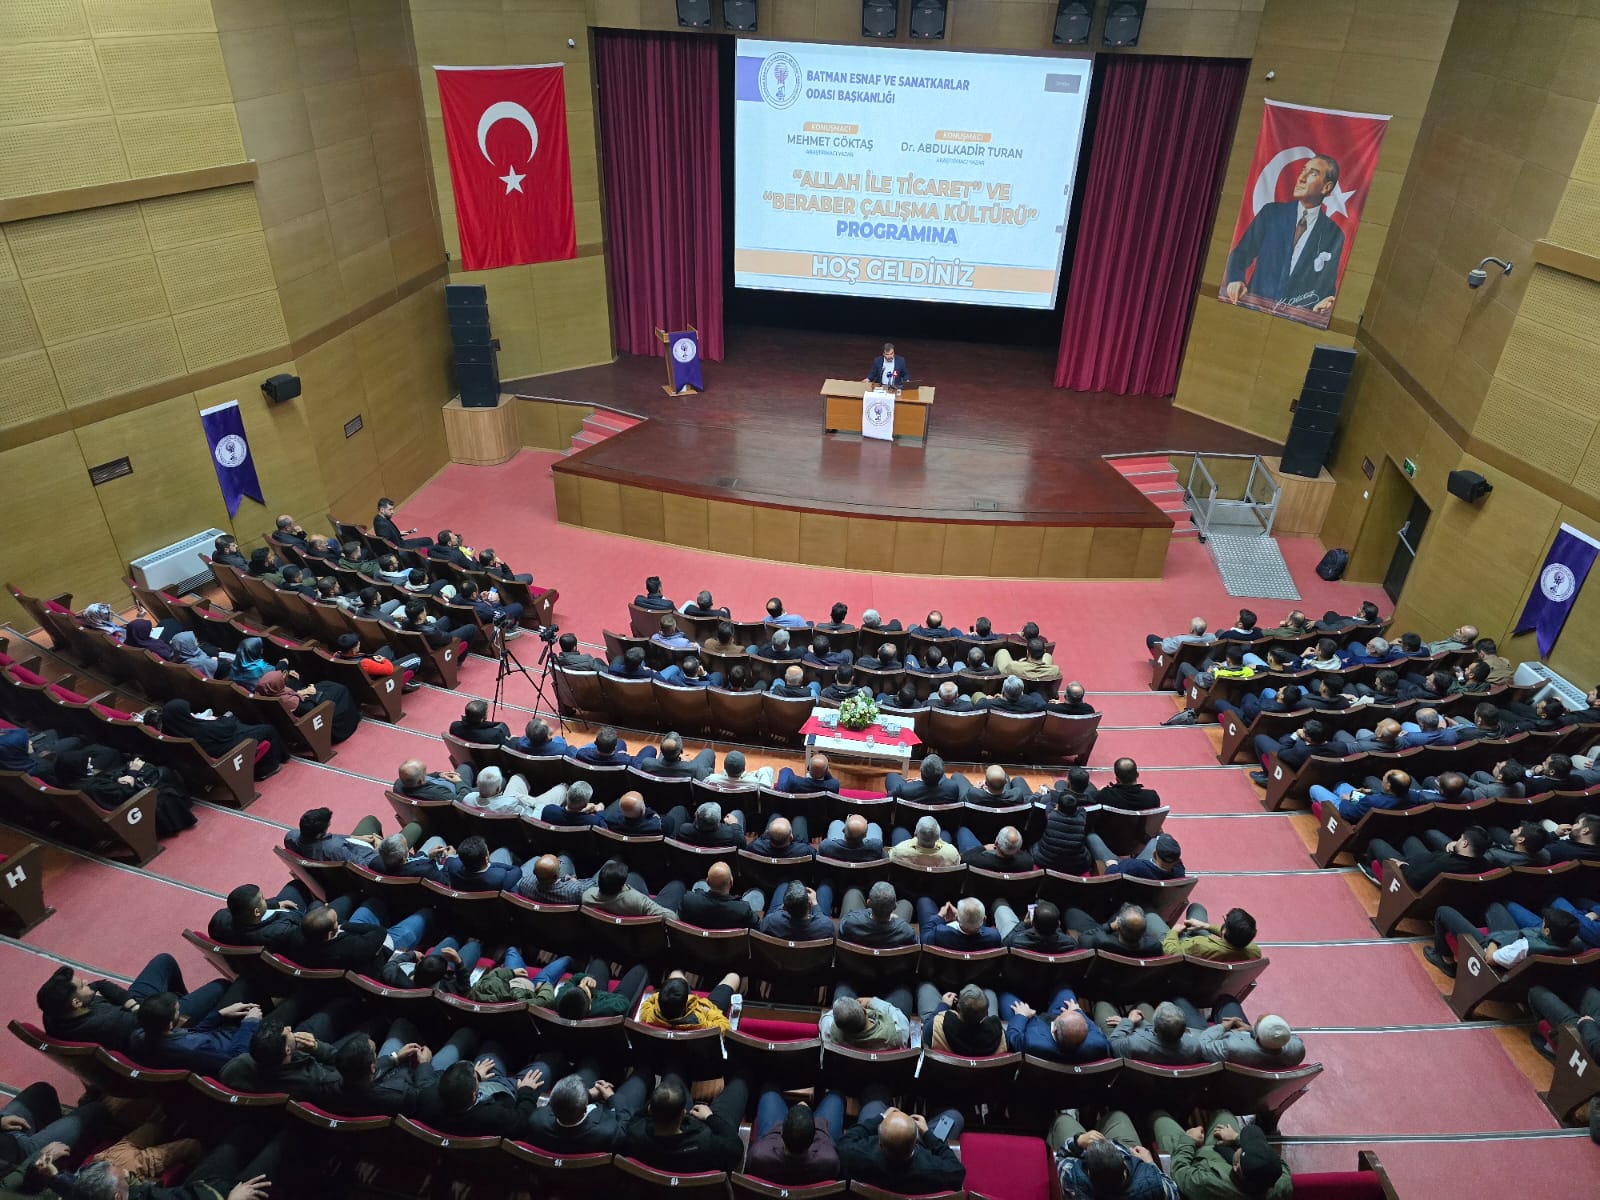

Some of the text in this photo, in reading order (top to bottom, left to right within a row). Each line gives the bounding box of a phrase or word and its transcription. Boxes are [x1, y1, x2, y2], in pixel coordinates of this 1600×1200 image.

[806, 70, 970, 91] BATMAN ESNAF VE SANATKARLAR
[806, 88, 896, 104] ODASI BAŞKANLIĞI
[787, 134, 874, 151] MEHMET GÖKTAŞ
[901, 142, 1024, 159] Dr. ABDULKADİR TURAN
[865, 170, 893, 194] İLE
[986, 182, 1012, 201] VE
[860, 198, 940, 223] ÇALIŞMA
[836, 220, 958, 244] PROGRAMINA
[812, 254, 975, 288] HOŞ GELDİNİZ
[543, 598, 550, 610] A
[1157, 654, 1164, 667] A
[385, 678, 395, 693] D
[312, 714, 324, 730] E
[233, 754, 244, 771] F
[1273, 765, 1282, 780] D
[127, 807, 143, 825] G
[1327, 816, 1338, 834] E
[6, 865, 27, 889] H
[1389, 878, 1401, 893] F
[1467, 956, 1481, 976] G
[1569, 1049, 1588, 1077] H
